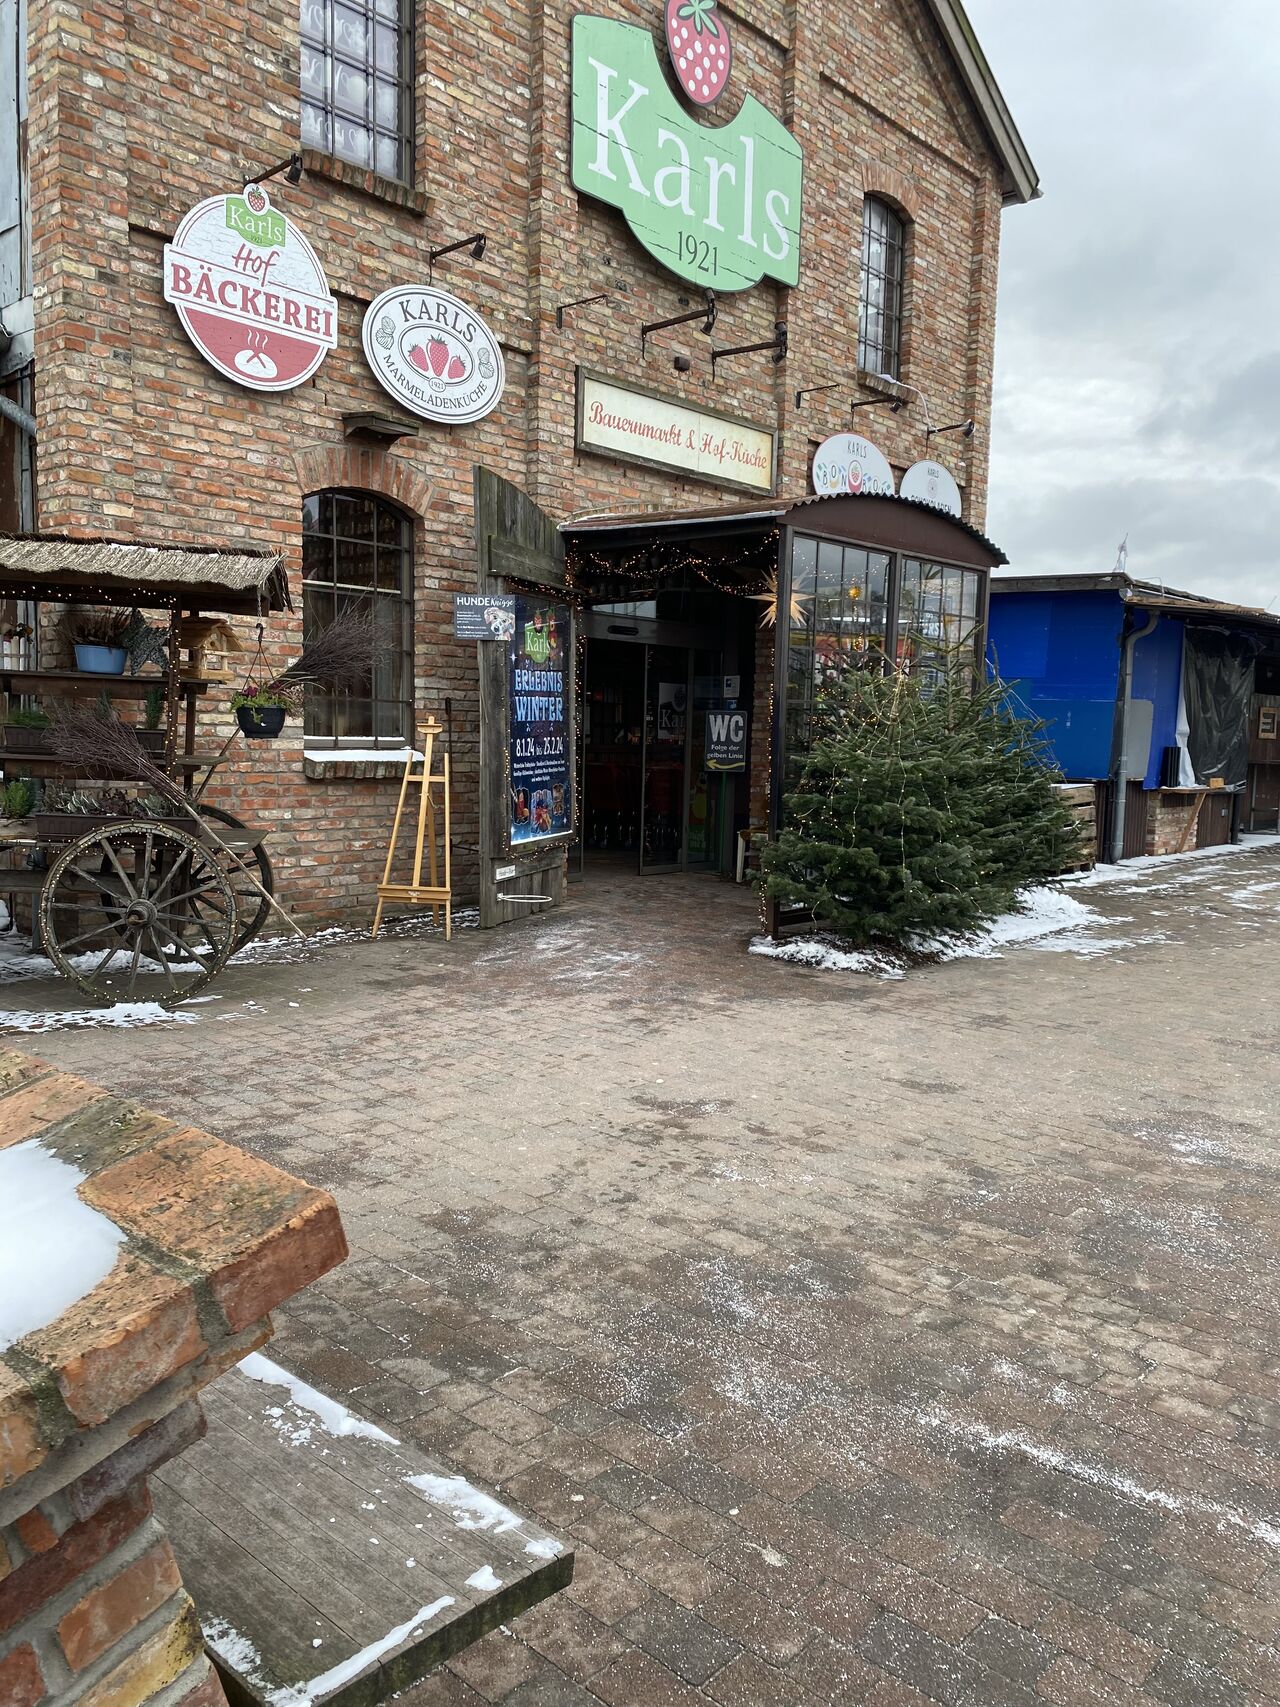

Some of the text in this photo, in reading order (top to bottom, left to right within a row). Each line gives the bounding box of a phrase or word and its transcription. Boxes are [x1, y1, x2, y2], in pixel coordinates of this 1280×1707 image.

[588, 56, 790, 261] Karls
[230, 205, 283, 242] Karls
[232, 243, 280, 287] Hof
[677, 230, 718, 276] 1921
[170, 263, 333, 338] BÄCKEREI
[399, 299, 477, 343] KARLS
[383, 354, 488, 409] MARMELADENKÜCHE
[430, 380, 445, 390] 1921
[589, 401, 682, 447] Bauernmarkt
[686, 430, 695, 450] &
[847, 440, 867, 459] KARLS
[927, 467, 940, 479] KARLS
[456, 596, 491, 606] HUNDE
[515, 669, 563, 692] ERLEBNIS
[514, 696, 563, 721] WINTER
[708, 714, 744, 742] WC
[516, 737, 535, 757] 8.1.24
[543, 737, 564, 755] 25.2.24
[706, 752, 727, 760] gelben
[711, 744, 728, 752] Folge
